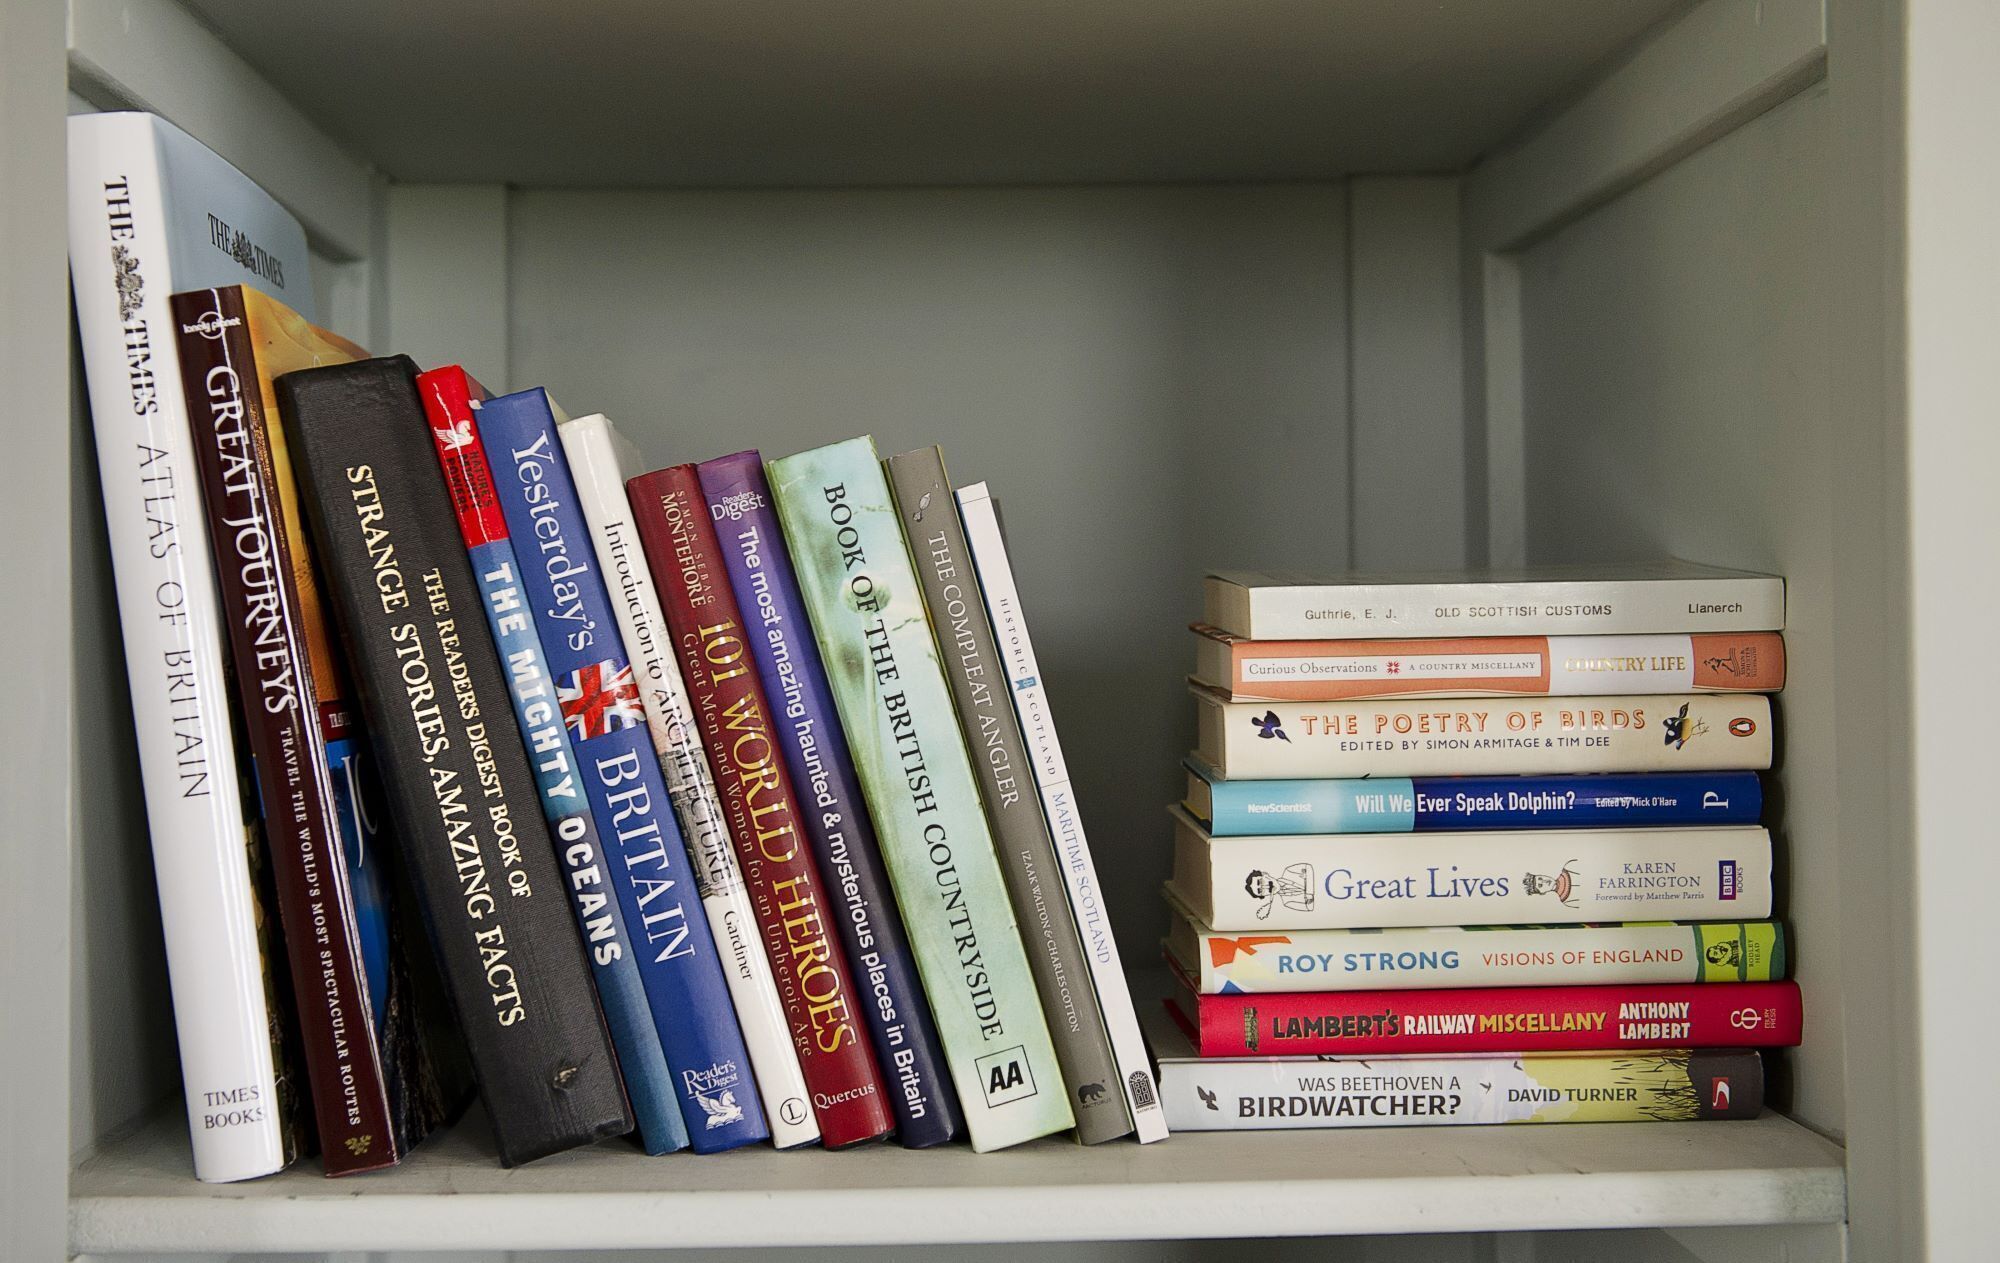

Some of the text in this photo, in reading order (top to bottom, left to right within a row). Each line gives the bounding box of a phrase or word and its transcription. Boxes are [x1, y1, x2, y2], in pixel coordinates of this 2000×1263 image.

[207, 212, 285, 289] THE TIMES
[104, 176, 158, 417] THE TIMES
[206, 365, 261, 501] GREAT
[711, 494, 765, 520] Digest
[661, 492, 707, 608] MONTEFIORE
[677, 490, 715, 603] SIMON SEBAG
[222, 516, 298, 713] JOURNEYS
[604, 521, 655, 655] Introduction
[648, 657, 663, 680] to
[1305, 608, 1397, 621] Guthrie, E. J.
[1434, 604, 1612, 618] OLD SCOTTISH CUSTOMS
[1688, 602, 1743, 614] Llanerch
[136, 444, 210, 799] ATLAS OF BRITAIN
[928, 530, 1020, 809] THE COMPLEAT ANGLER
[1249, 661, 1378, 675] Curious Observations
[1419, 663, 1468, 671] COUNTRY
[1471, 661, 1536, 670] MISCELLANY
[1565, 656, 1686, 672] COUNTRY LIFE
[511, 430, 695, 964] Yesterday's BRITAIN
[1000, 598, 1056, 776] HISTORIC SCOTLAND
[423, 567, 532, 898] THE READER'S DIGEST BOOK OF
[1300, 708, 1646, 736] THE POETRY OF BIRDS
[346, 464, 526, 1027] STRANGE STORIES, AMAZING FACTS
[1340, 736, 1610, 752] EDITED BY SIMON ARMITAGE & TIM DEE
[484, 562, 621, 966] THE MIGHTY OCEANS
[823, 482, 1004, 1042] BOOK OF THE BRITISH COUNTRYSIDE
[1355, 790, 1576, 815] Will We Ever Speak Dolphin?
[1596, 796, 1677, 809] Edited by Mick O'Hare
[698, 616, 857, 1053] 101 WORLD HEROES
[738, 525, 927, 1119] The most amazing haunted & mysterious places in Britain
[683, 633, 812, 1057] Great Men and Women for an Unheroic Age
[1052, 792, 1110, 964] MARITIME SCOTLAND
[1324, 865, 1510, 900] Great Lives
[1599, 876, 1701, 889] FARRINGTON
[1624, 862, 1676, 874] KAREN
[1723, 865, 1732, 895] BBC
[1595, 891, 1704, 902] Foreword by Matthew Parris
[280, 727, 361, 1126] TRAVEL THE WORLD'S MOST SPECTACULAR ROUTES
[1021, 850, 1080, 1033] IZAAK WALTON & CHARLES COTTON
[723, 910, 752, 980] Gardiner
[1482, 948, 1683, 967] VISIONS OF ENGLAND
[1278, 950, 1460, 973] ROY STRONG
[1273, 1009, 1606, 1040] LAMBERT'S RAILWAY MISCELLANY
[1619, 1002, 1690, 1020] ANTHONY
[1619, 1022, 1691, 1040] LAMBERT
[682, 1060, 737, 1094] Reader's
[707, 1073, 738, 1089] Digest
[989, 1060, 1024, 1094] AA
[1298, 1076, 1461, 1092] WAS BEETHOVEN A
[204, 1086, 259, 1106] TIMES
[814, 1082, 875, 1109] Quercus
[1238, 1094, 1461, 1118] BIRDWATCHER?
[1508, 1088, 1638, 1102] DAVID TURNER
[204, 1107, 265, 1129] BOOKS
